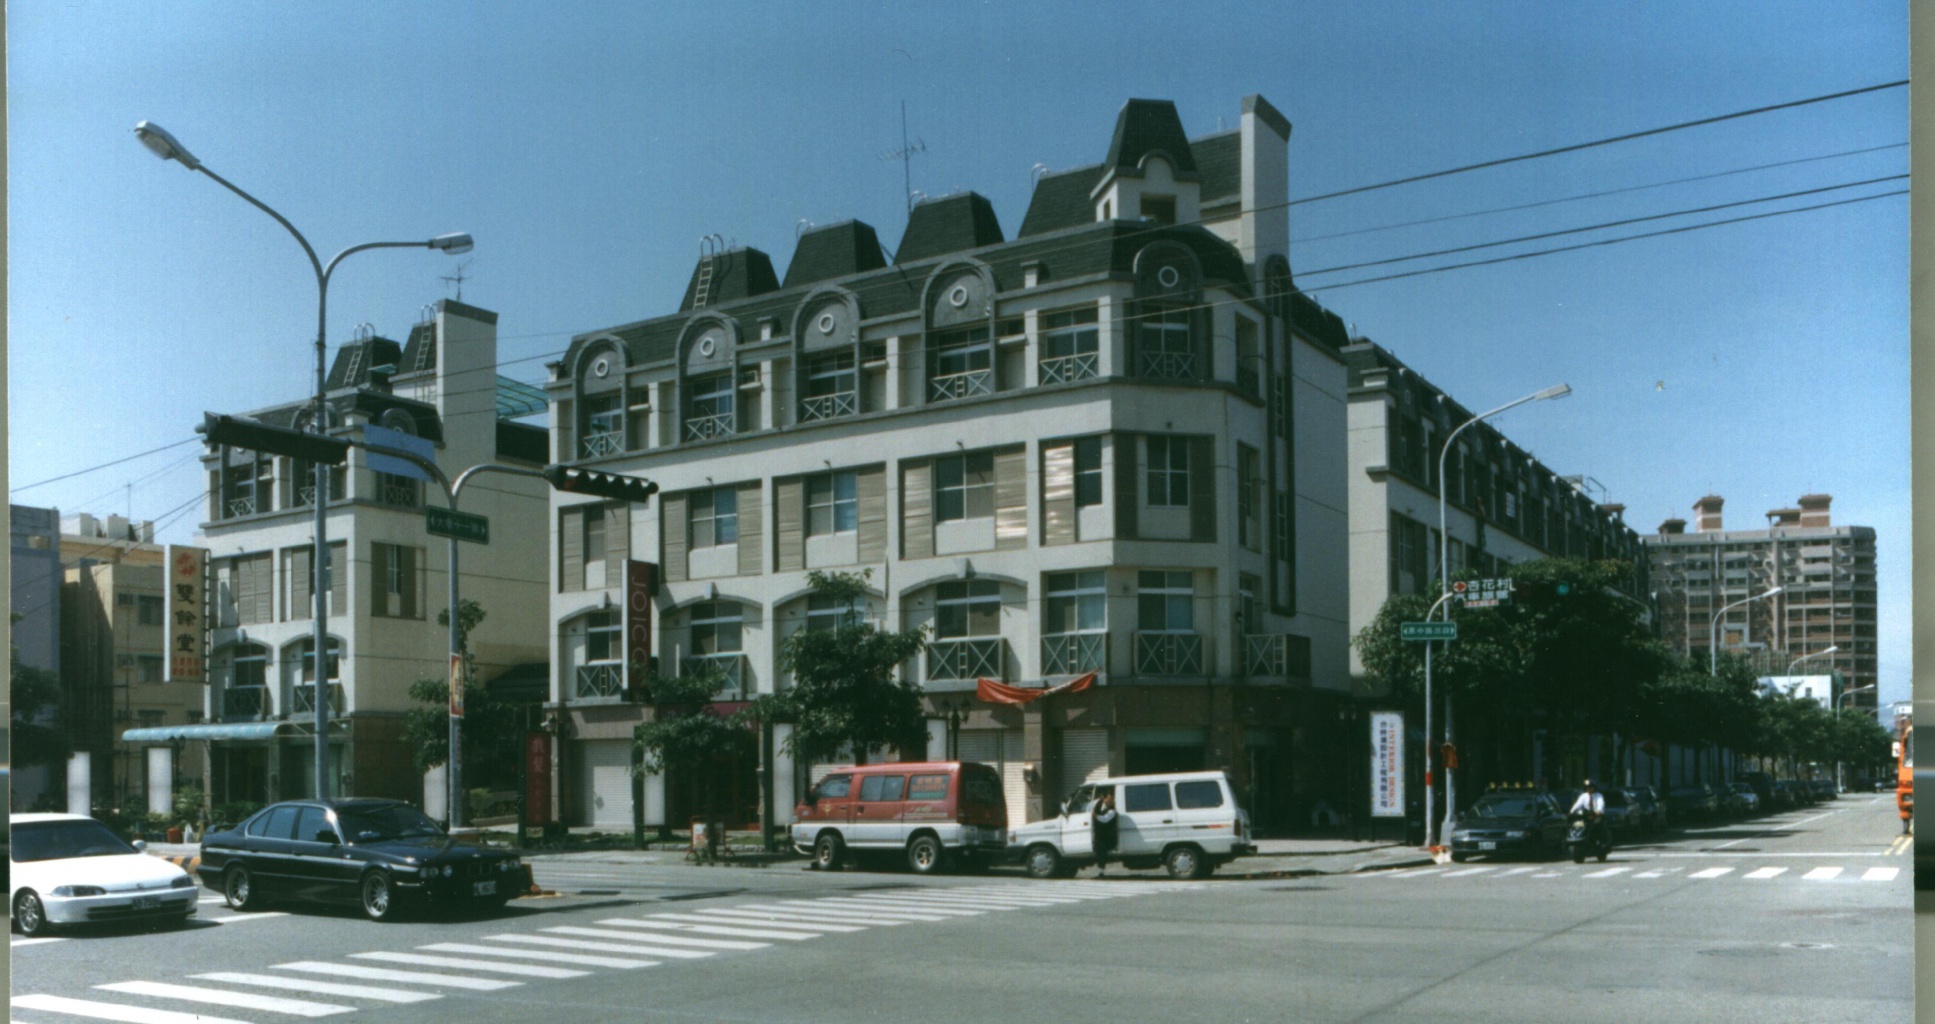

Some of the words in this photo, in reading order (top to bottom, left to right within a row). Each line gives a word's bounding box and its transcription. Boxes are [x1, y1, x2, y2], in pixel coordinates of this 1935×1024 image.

[1467, 577, 1509, 592] 杏花村
[175, 583, 197, 652] 雙餘堂
[1388, 729, 1396, 772] INTERIOR
[1388, 776, 1396, 808] DESIGN
